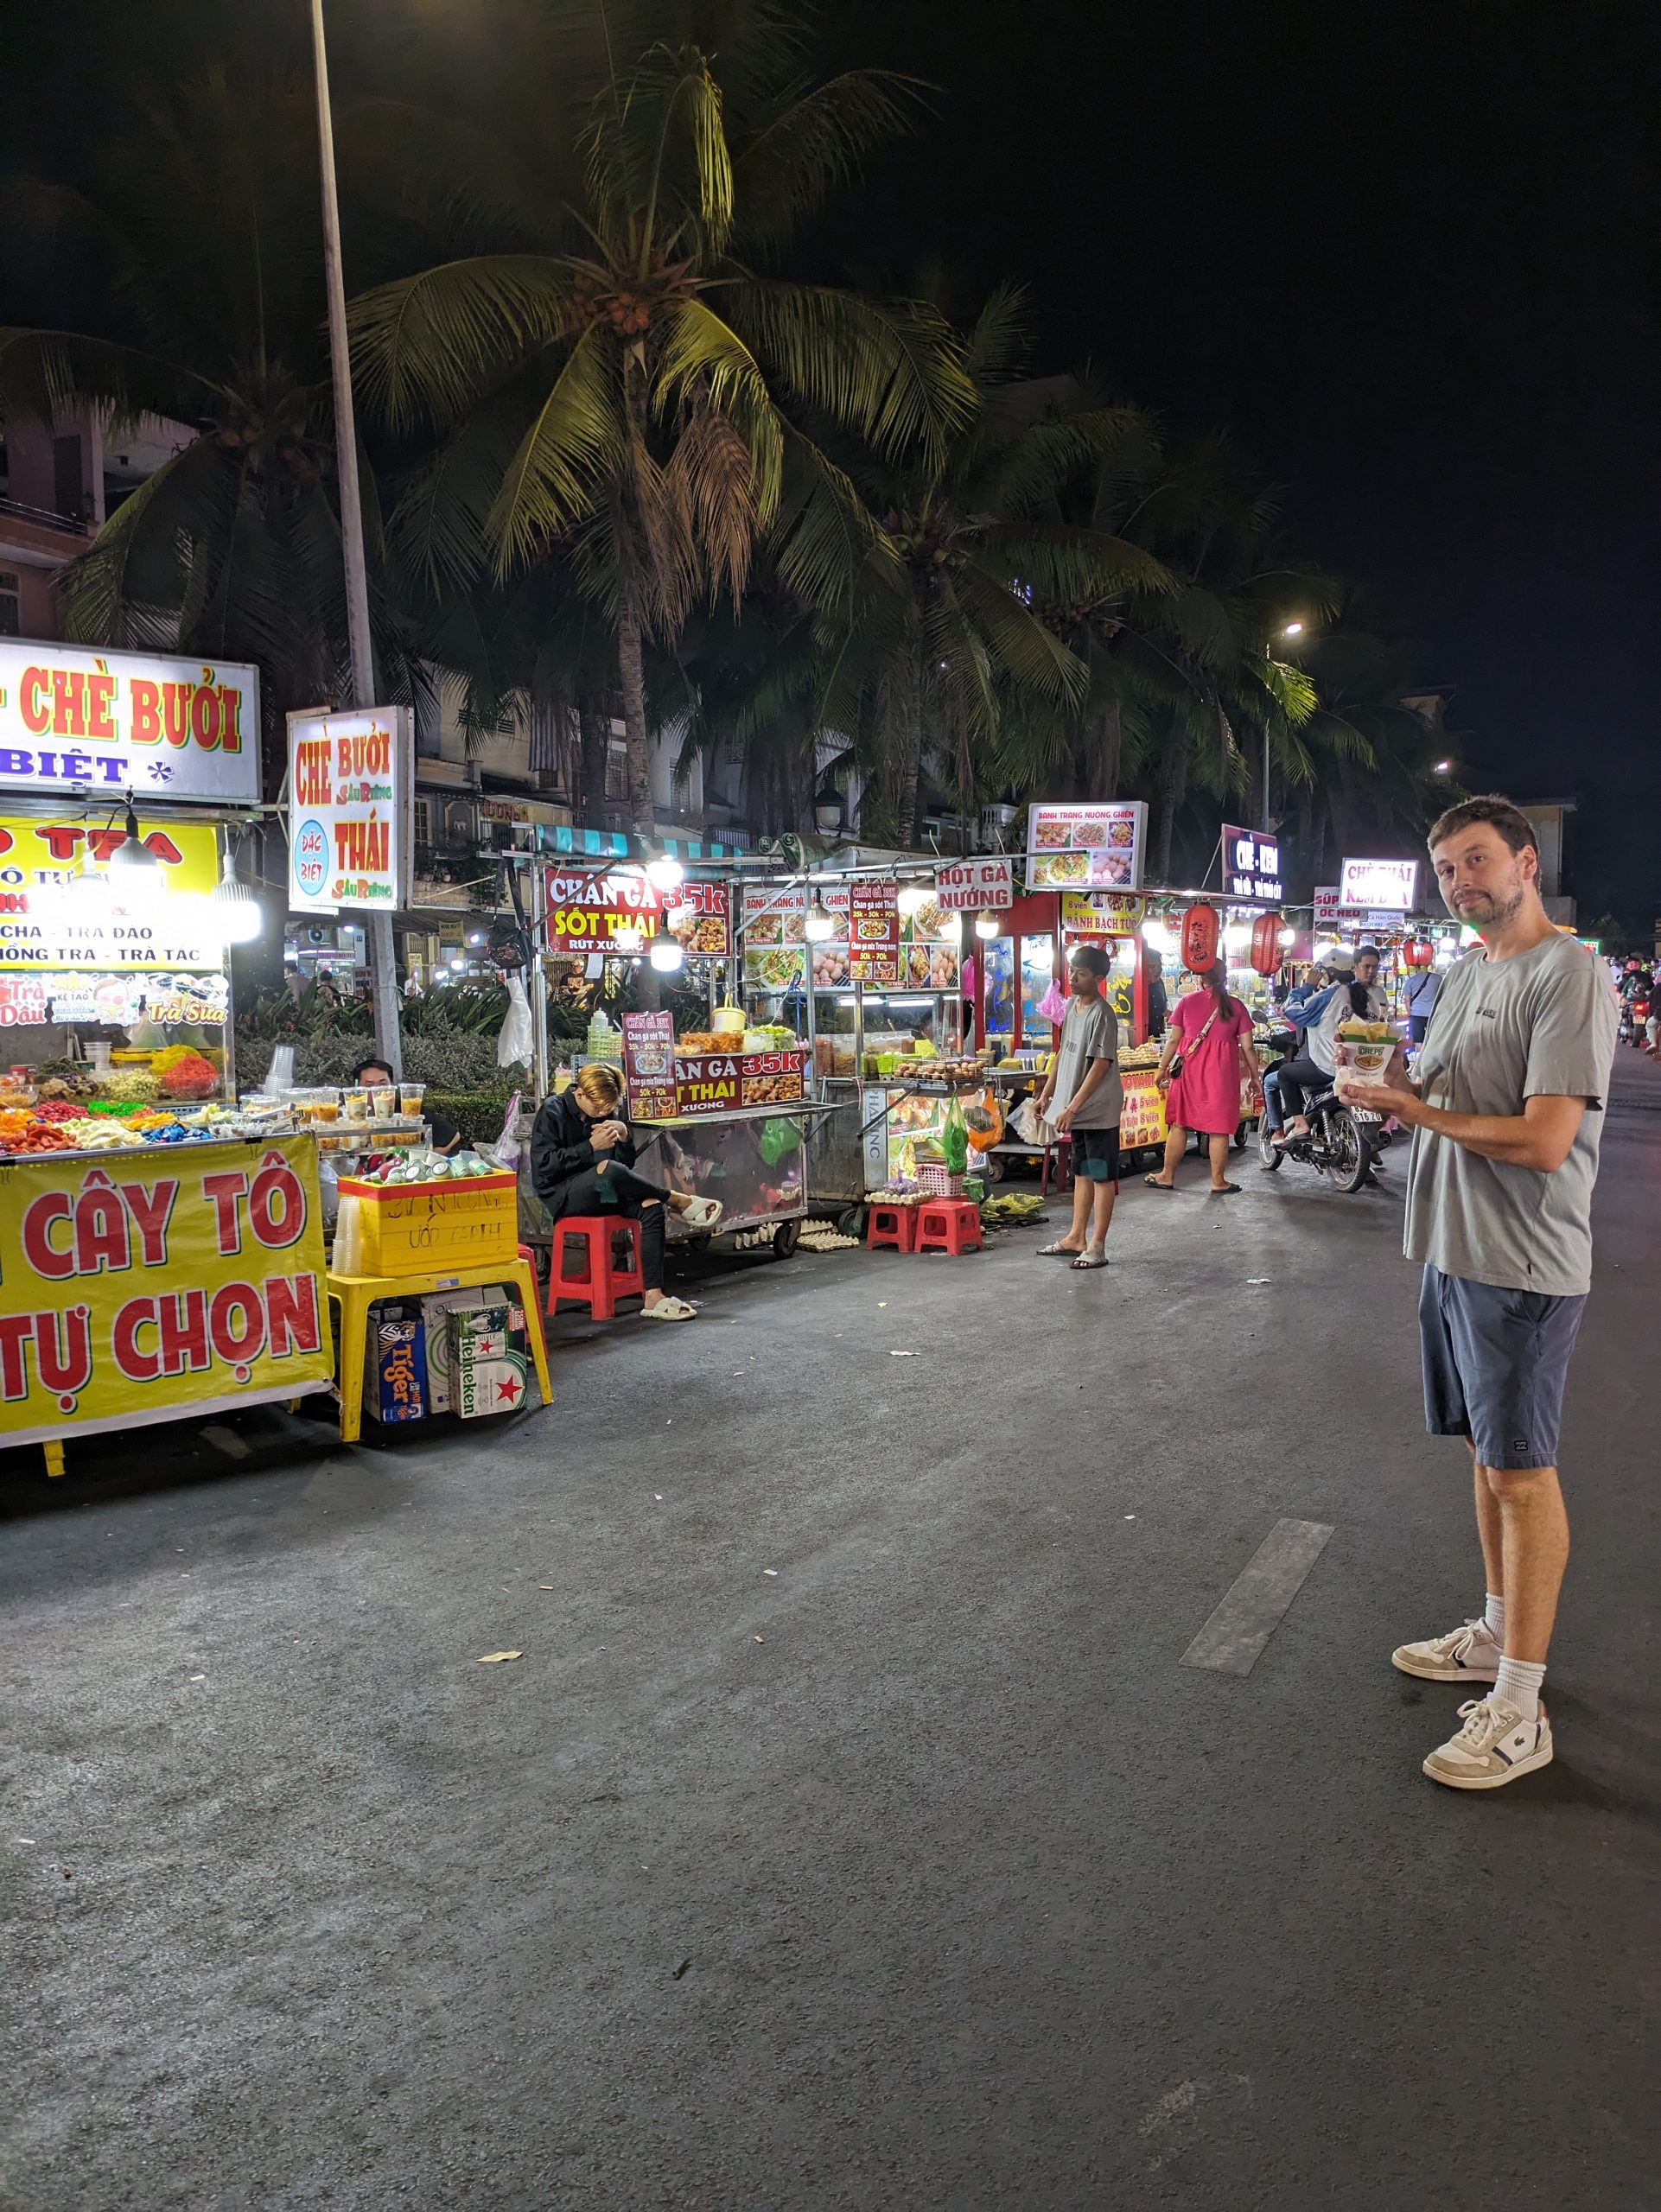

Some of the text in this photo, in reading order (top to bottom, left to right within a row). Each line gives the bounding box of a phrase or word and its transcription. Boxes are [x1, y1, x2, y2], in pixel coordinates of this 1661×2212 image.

[20, 659, 243, 753] CHÈ BƯỞI
[0, 748, 130, 787] BIỆT
[296, 721, 390, 805] CHÈ BƯỞI
[35, 827, 183, 864] TEA
[301, 830, 322, 856] ĐẶC
[334, 810, 390, 872] THÁI
[301, 858, 322, 886] BIỆT
[939, 863, 1009, 887] HỘT GÀ
[550, 874, 617, 906] CHÂN
[662, 883, 725, 914] 35k
[882, 887, 896, 898] 35K
[939, 887, 1008, 908] NƯỚNG
[1315, 893, 1339, 905] SÚP
[1074, 900, 1087, 910] viên
[554, 906, 655, 938] SỐT THÁI
[118, 946, 156, 961] TRÀ
[570, 938, 594, 950] RÚT
[11, 980, 45, 1001] Trà
[0, 1003, 46, 1025] Dâu
[148, 1001, 227, 1025] Trà Sữa
[657, 1017, 669, 1028] 35K
[676, 1052, 800, 1080] ÂN GÀ 35k
[640, 1089, 651, 1097] 50k
[655, 1088, 666, 1096] 70k
[689, 1080, 735, 1102] THÁI
[1140, 1096, 1145, 1108] 5
[681, 1100, 724, 1113] XƯƠNG
[1140, 1112, 1145, 1125] 8
[22, 1149, 308, 1281] CÂY TÔ
[0, 1272, 323, 1414] TỰ CHỌN
[383, 1344, 415, 1403] Tiger
[461, 1333, 476, 1415] Heineken
